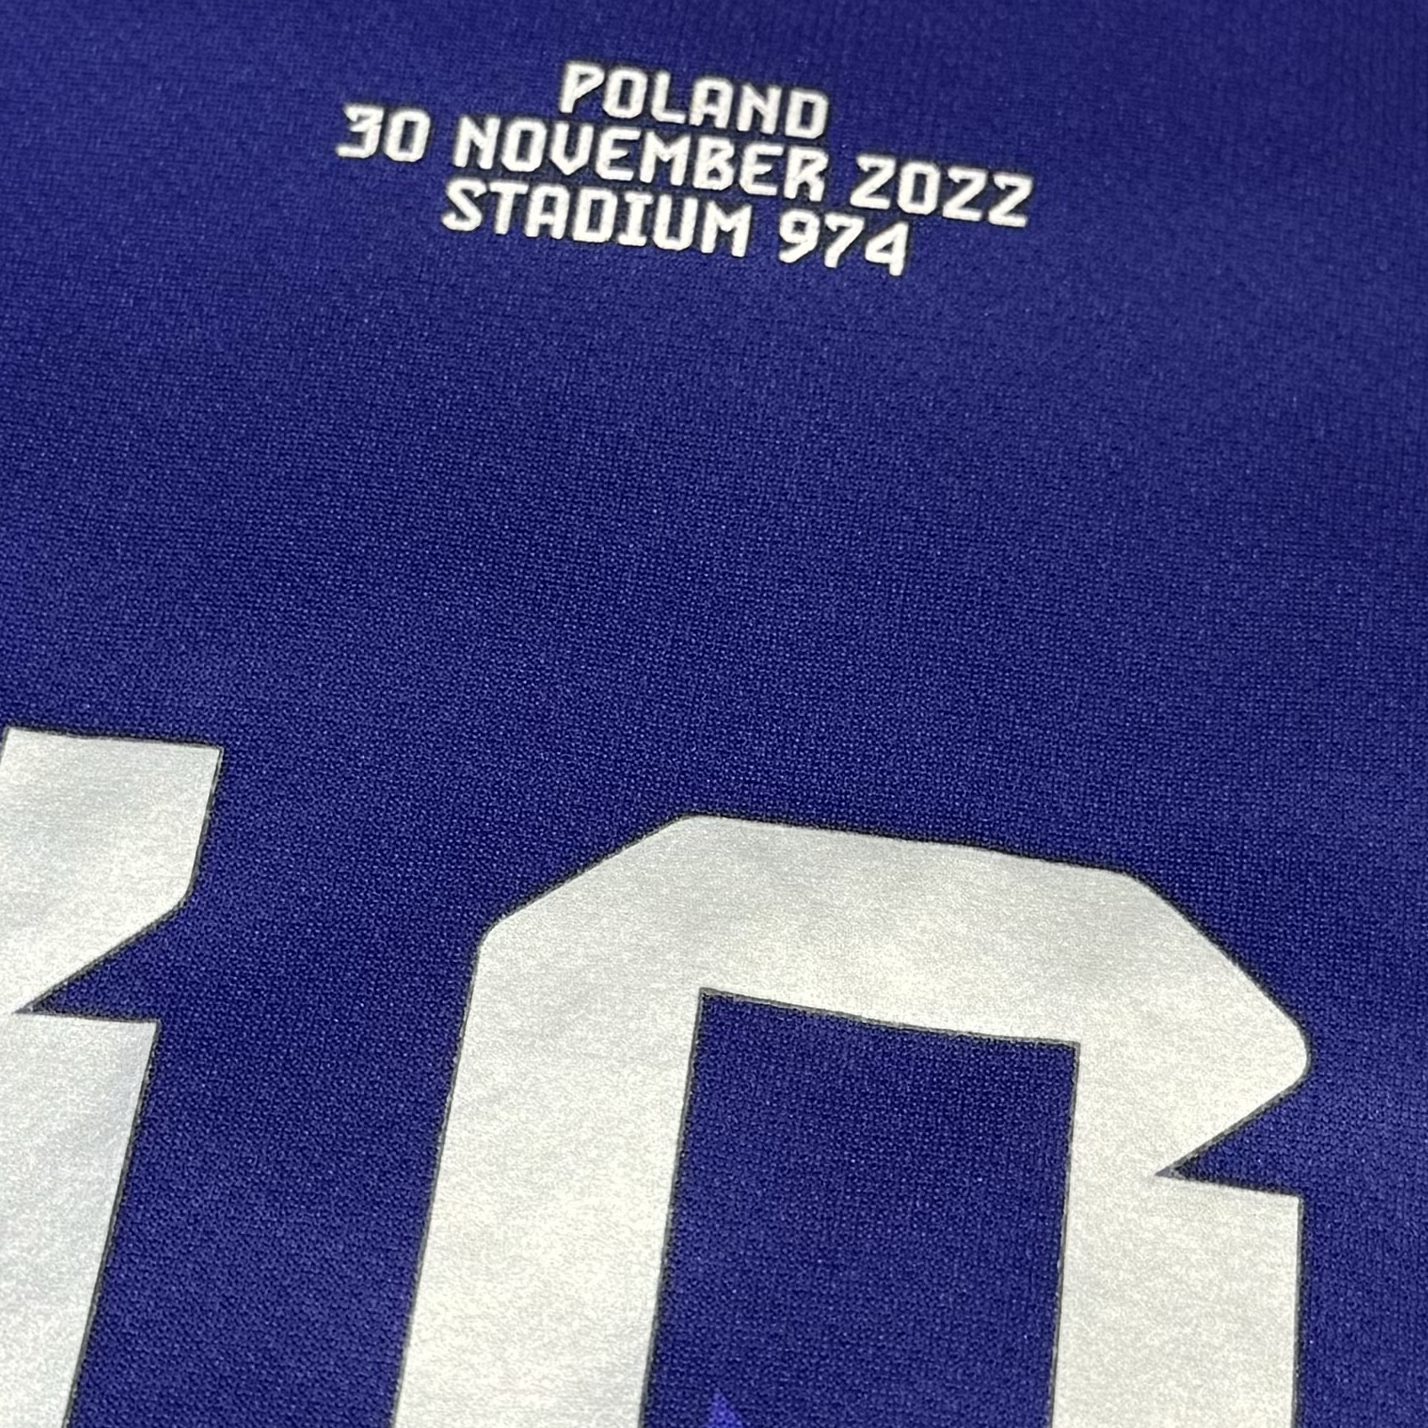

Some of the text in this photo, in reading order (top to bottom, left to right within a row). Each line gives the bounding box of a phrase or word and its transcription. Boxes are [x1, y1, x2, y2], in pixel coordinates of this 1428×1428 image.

[560, 61, 830, 139] POLAND
[336, 104, 1034, 228] 30 NOVEMBER 2022
[441, 178, 910, 276] STADIUM 974
